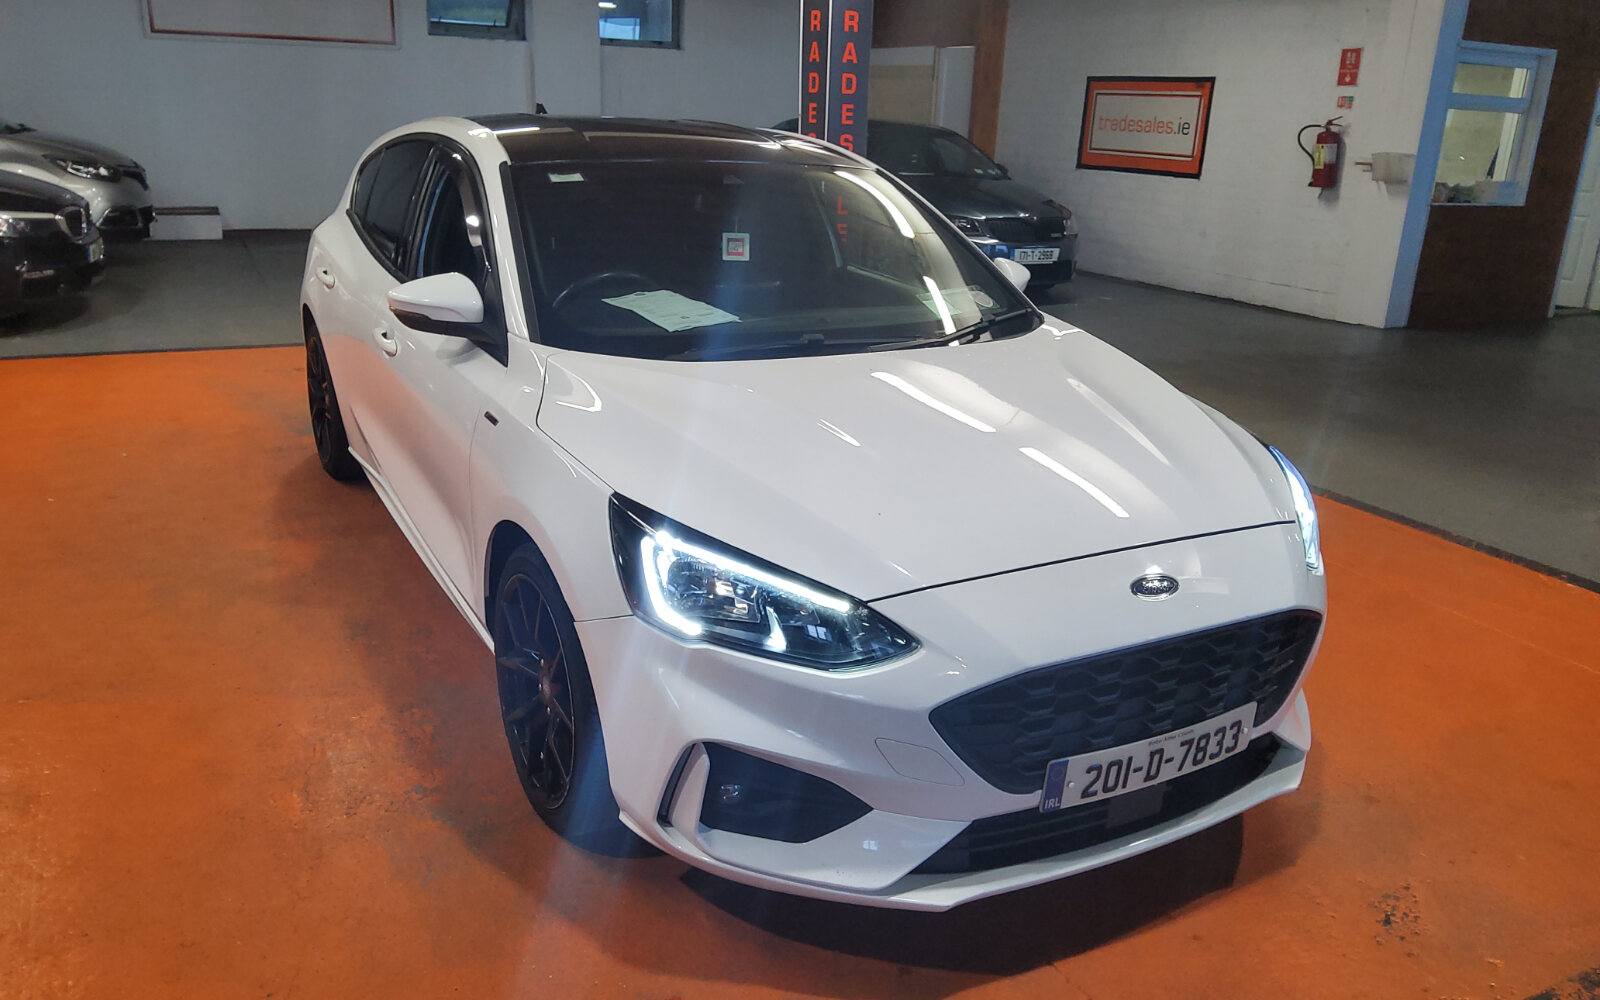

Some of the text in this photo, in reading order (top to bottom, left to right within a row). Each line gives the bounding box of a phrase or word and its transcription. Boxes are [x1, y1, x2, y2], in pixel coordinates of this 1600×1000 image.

[808, 9, 821, 139] RADE
[1098, 114, 1191, 136] tradesales.ie
[1080, 719, 1243, 800] 201-D-7833
[1043, 797, 1061, 810] IRL
